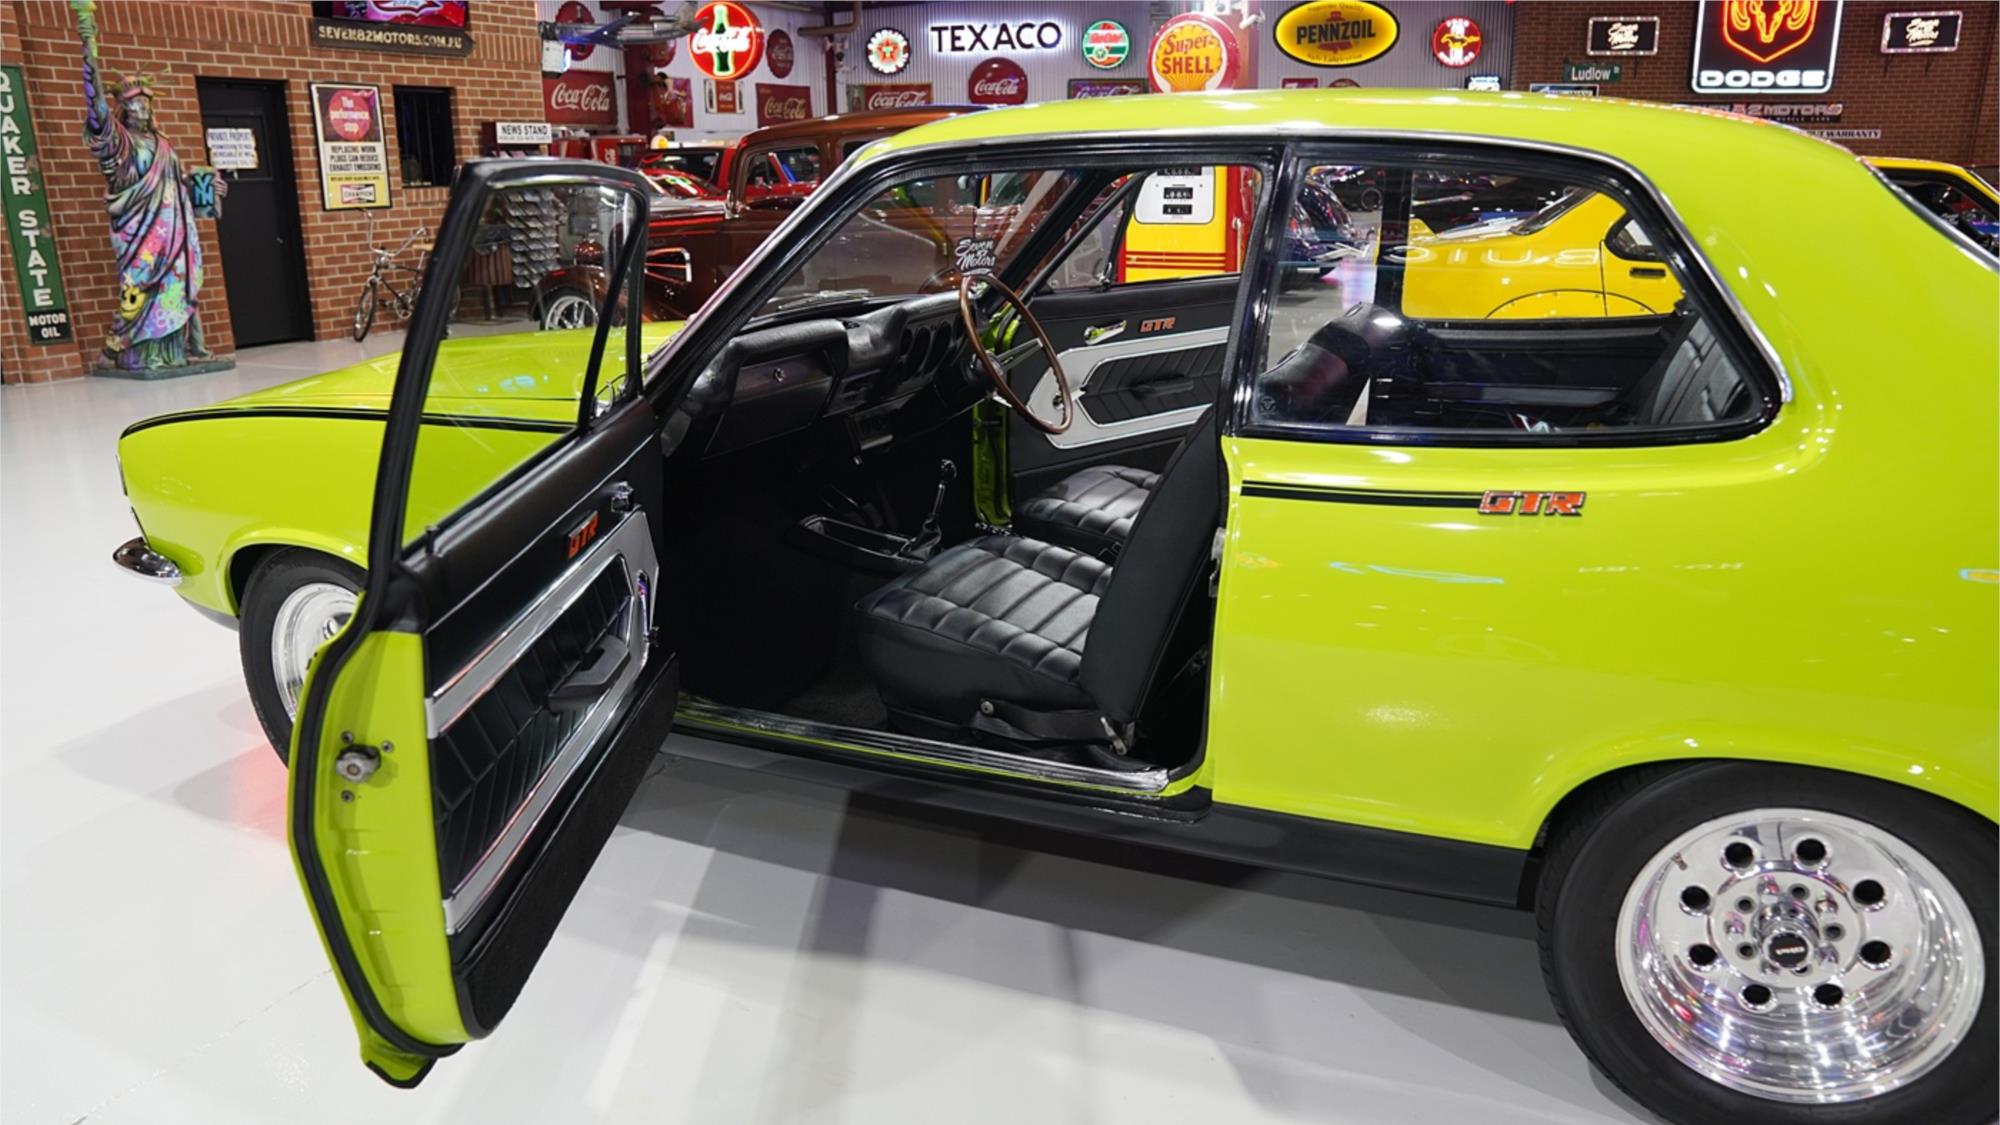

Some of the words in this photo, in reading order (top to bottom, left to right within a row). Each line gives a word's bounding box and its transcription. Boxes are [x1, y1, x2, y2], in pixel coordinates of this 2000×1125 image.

[930, 22, 1062, 52] TEXACO
[1296, 19, 1376, 45] PENNZOIL
[1163, 34, 1208, 55] Super
[1162, 56, 1213, 75] SHELL
[1571, 66, 1611, 80] Ludlow
[1700, 70, 1826, 87] DODGE
[551, 82, 611, 111] Coca-Cola
[974, 79, 1020, 97] Coca-Cola
[1764, 104, 1843, 116] MOTORS
[0, 71, 32, 195] QUAKER
[501, 125, 522, 135] NEWS
[524, 125, 547, 135] STAND
[955, 239, 994, 256] Seven
[18, 210, 53, 307] STATE
[956, 254, 996, 270] Motors
[28, 313, 67, 327] MOTOR
[1140, 316, 1176, 332] GTR
[41, 327, 61, 338] OIL
[1479, 490, 1585, 516] GTR
[567, 511, 600, 560] GTR
